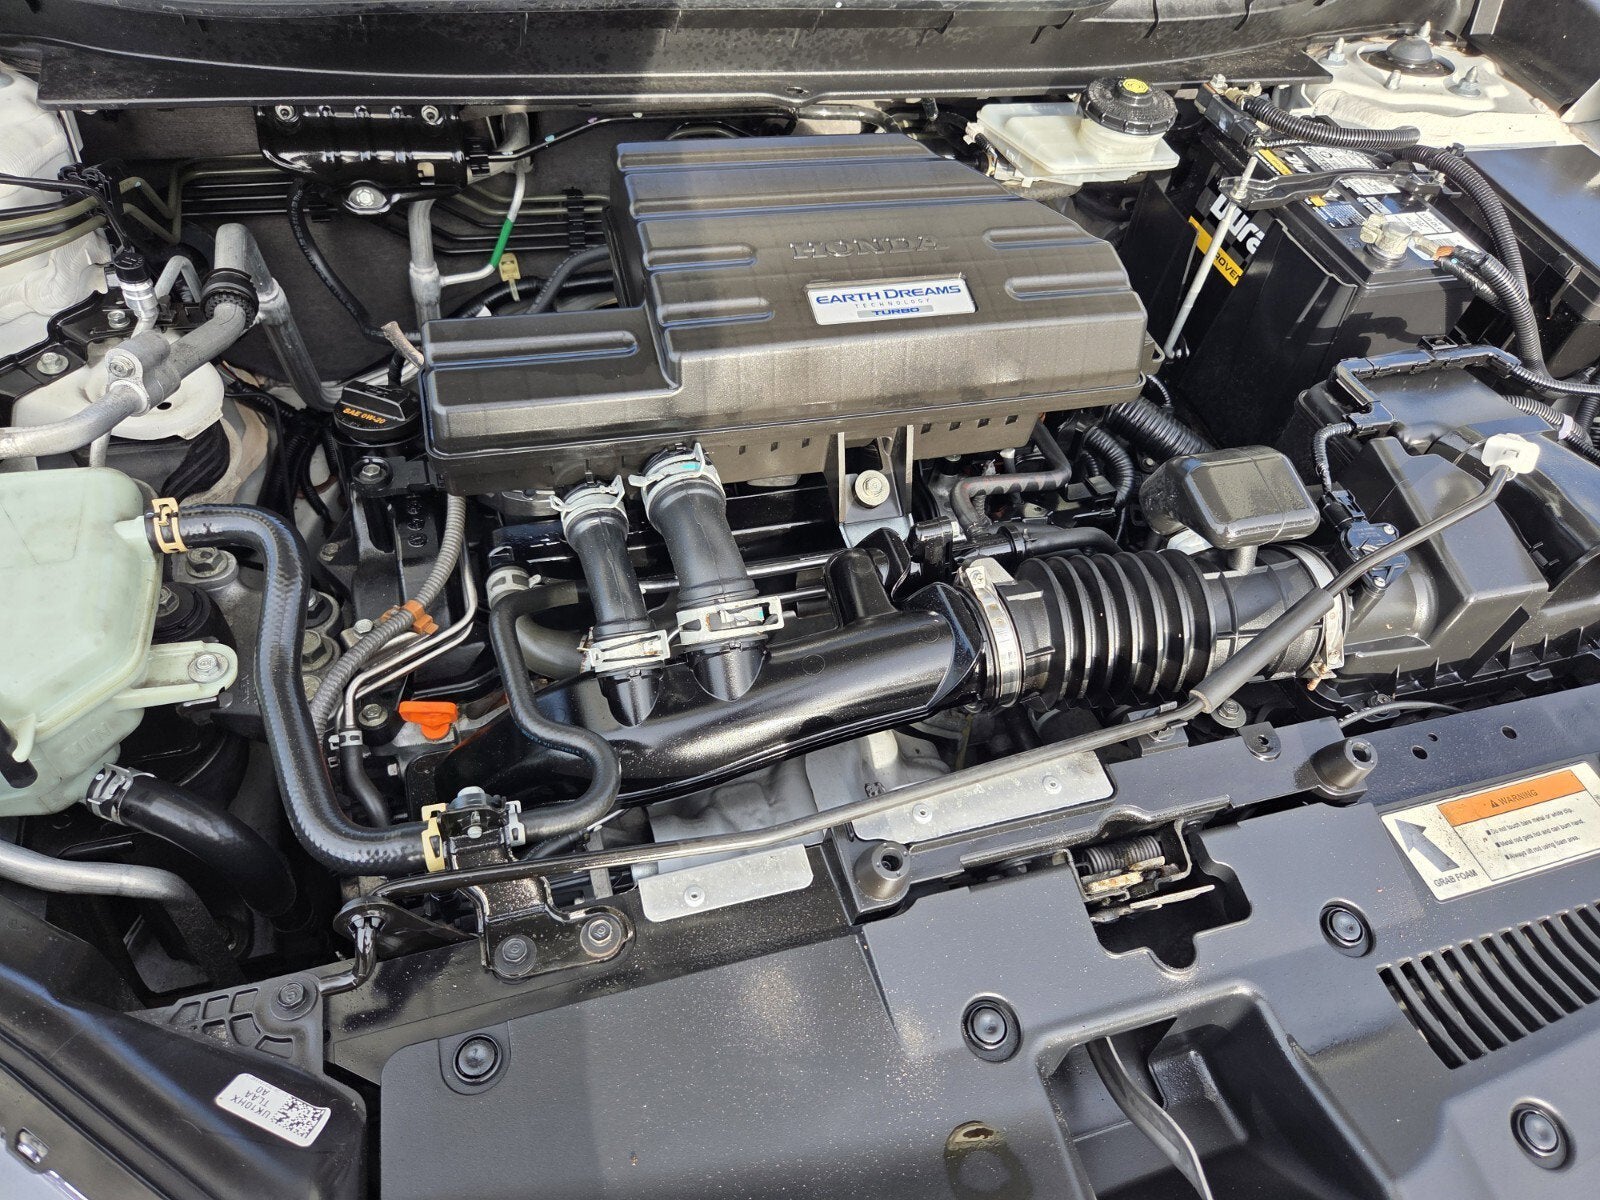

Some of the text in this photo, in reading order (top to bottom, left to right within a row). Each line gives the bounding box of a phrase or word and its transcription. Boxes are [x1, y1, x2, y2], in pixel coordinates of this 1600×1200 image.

[789, 235, 950, 260] HONDA
[816, 285, 961, 305] EARTH DREAMS
[855, 299, 931, 308] TECHNOLOGY
[872, 307, 920, 316] TURBO
[342, 408, 362, 417] SAE
[1497, 789, 1538, 805] WARNING
[1434, 868, 1479, 888] GRAB FOAM
[230, 1094, 271, 1119] UK10HX
[245, 1090, 269, 1107] TLAA
